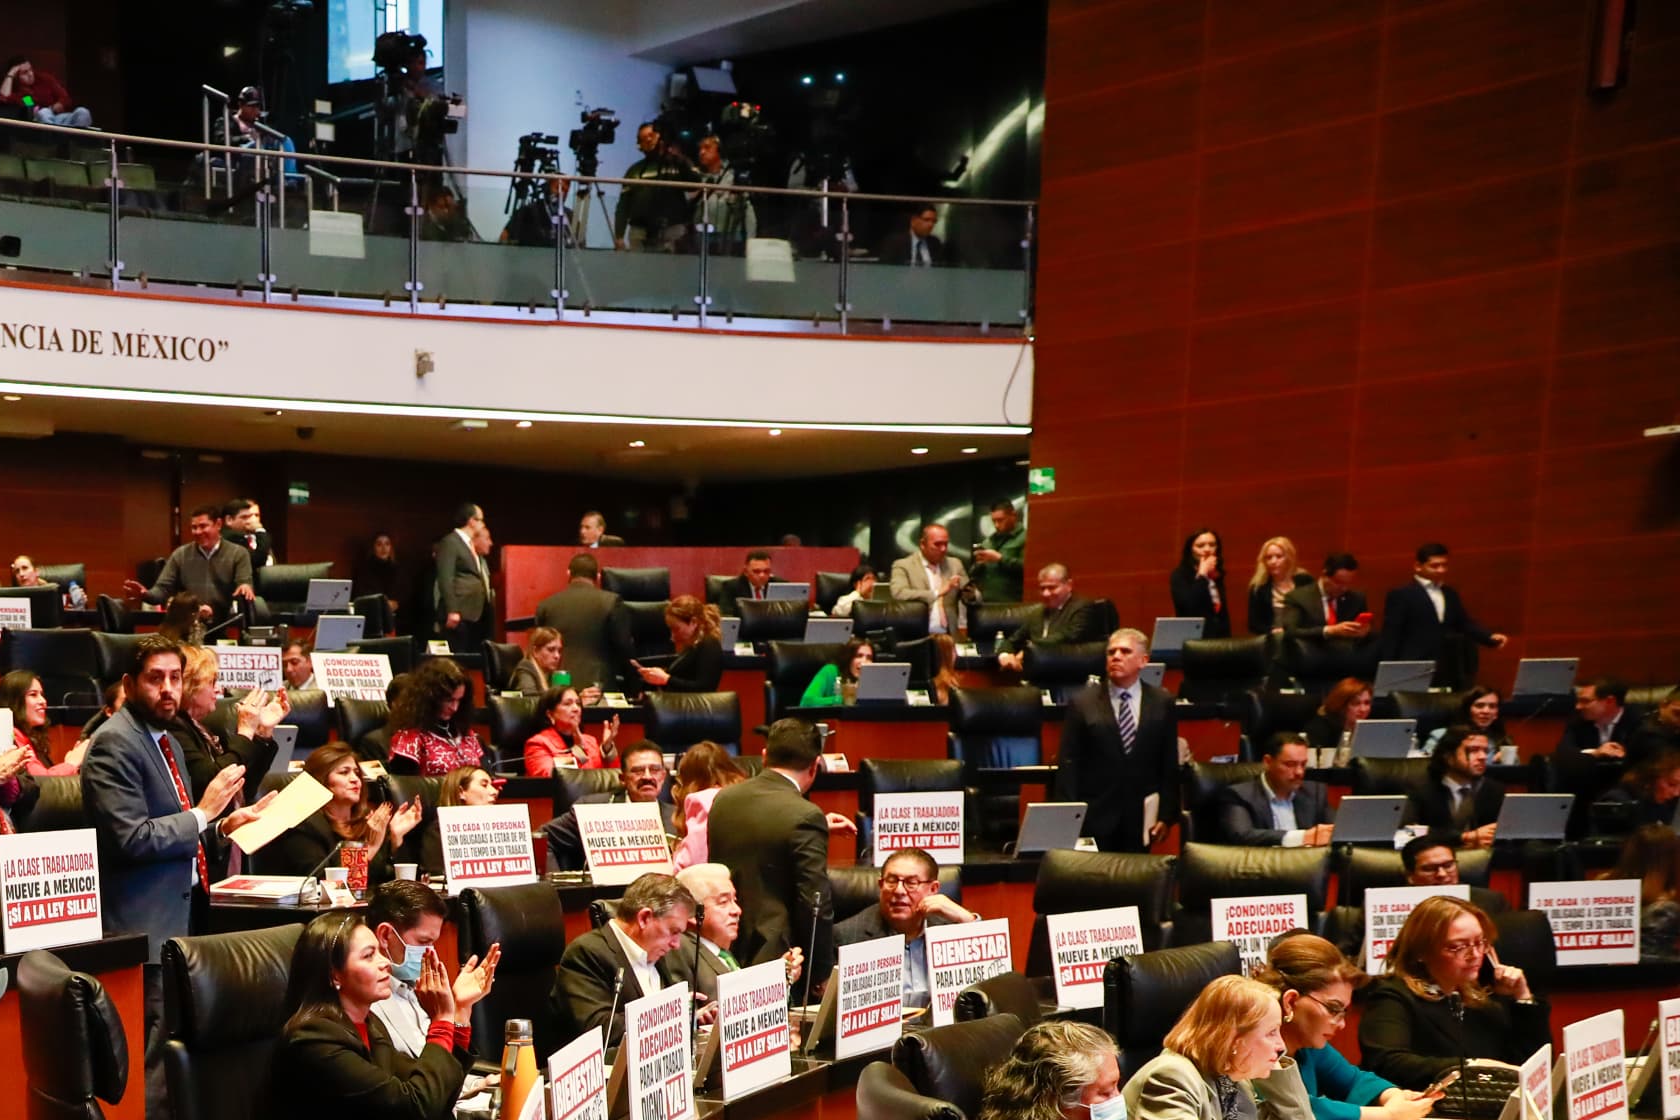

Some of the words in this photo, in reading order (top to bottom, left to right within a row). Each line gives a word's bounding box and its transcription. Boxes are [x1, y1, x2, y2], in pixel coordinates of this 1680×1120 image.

[72, 328, 103, 355] DE
[113, 328, 230, 363] MÉXICO”
[878, 822, 909, 833] MUEVE
[912, 822, 919, 832] A
[922, 821, 960, 832] MÉXICO!
[3, 861, 16, 882] ¡LA
[17, 858, 40, 877] CLASE
[41, 852, 94, 874] TRABAJADORA
[5, 881, 40, 901] MUEVE
[43, 880, 51, 896] A
[53, 875, 95, 895] MÉXICO!
[8, 907, 22, 926] ¡SÍ
[23, 906, 31, 921] A
[32, 904, 46, 920] LA
[47, 901, 64, 918] LEY
[66, 898, 97, 915] SILLA!
[1227, 918, 1295, 936] ADECUADAS
[933, 936, 1006, 964] BIENESTAR
[1057, 949, 1089, 964] MUEVE
[1092, 948, 1098, 960] A
[935, 970, 954, 988] PARA
[954, 968, 963, 986] LA
[964, 965, 985, 984] CLASE
[731, 993, 748, 1016] CLASE
[749, 983, 785, 1009] TRABAJADORA
[724, 1018, 749, 1042] MUEVE
[750, 1016, 756, 1033] A
[757, 1006, 786, 1030] MÉXICO!
[639, 1022, 682, 1061] ADECUADAS
[736, 1044, 745, 1062] A
[743, 1042, 754, 1060] LA
[753, 1037, 766, 1056] LEY
[766, 1031, 788, 1051] SILLA!
[639, 1062, 654, 1090] PARA
[653, 1058, 662, 1083] UN
[662, 1048, 684, 1077] TRABAJO
[667, 1076, 686, 1117] YA!
